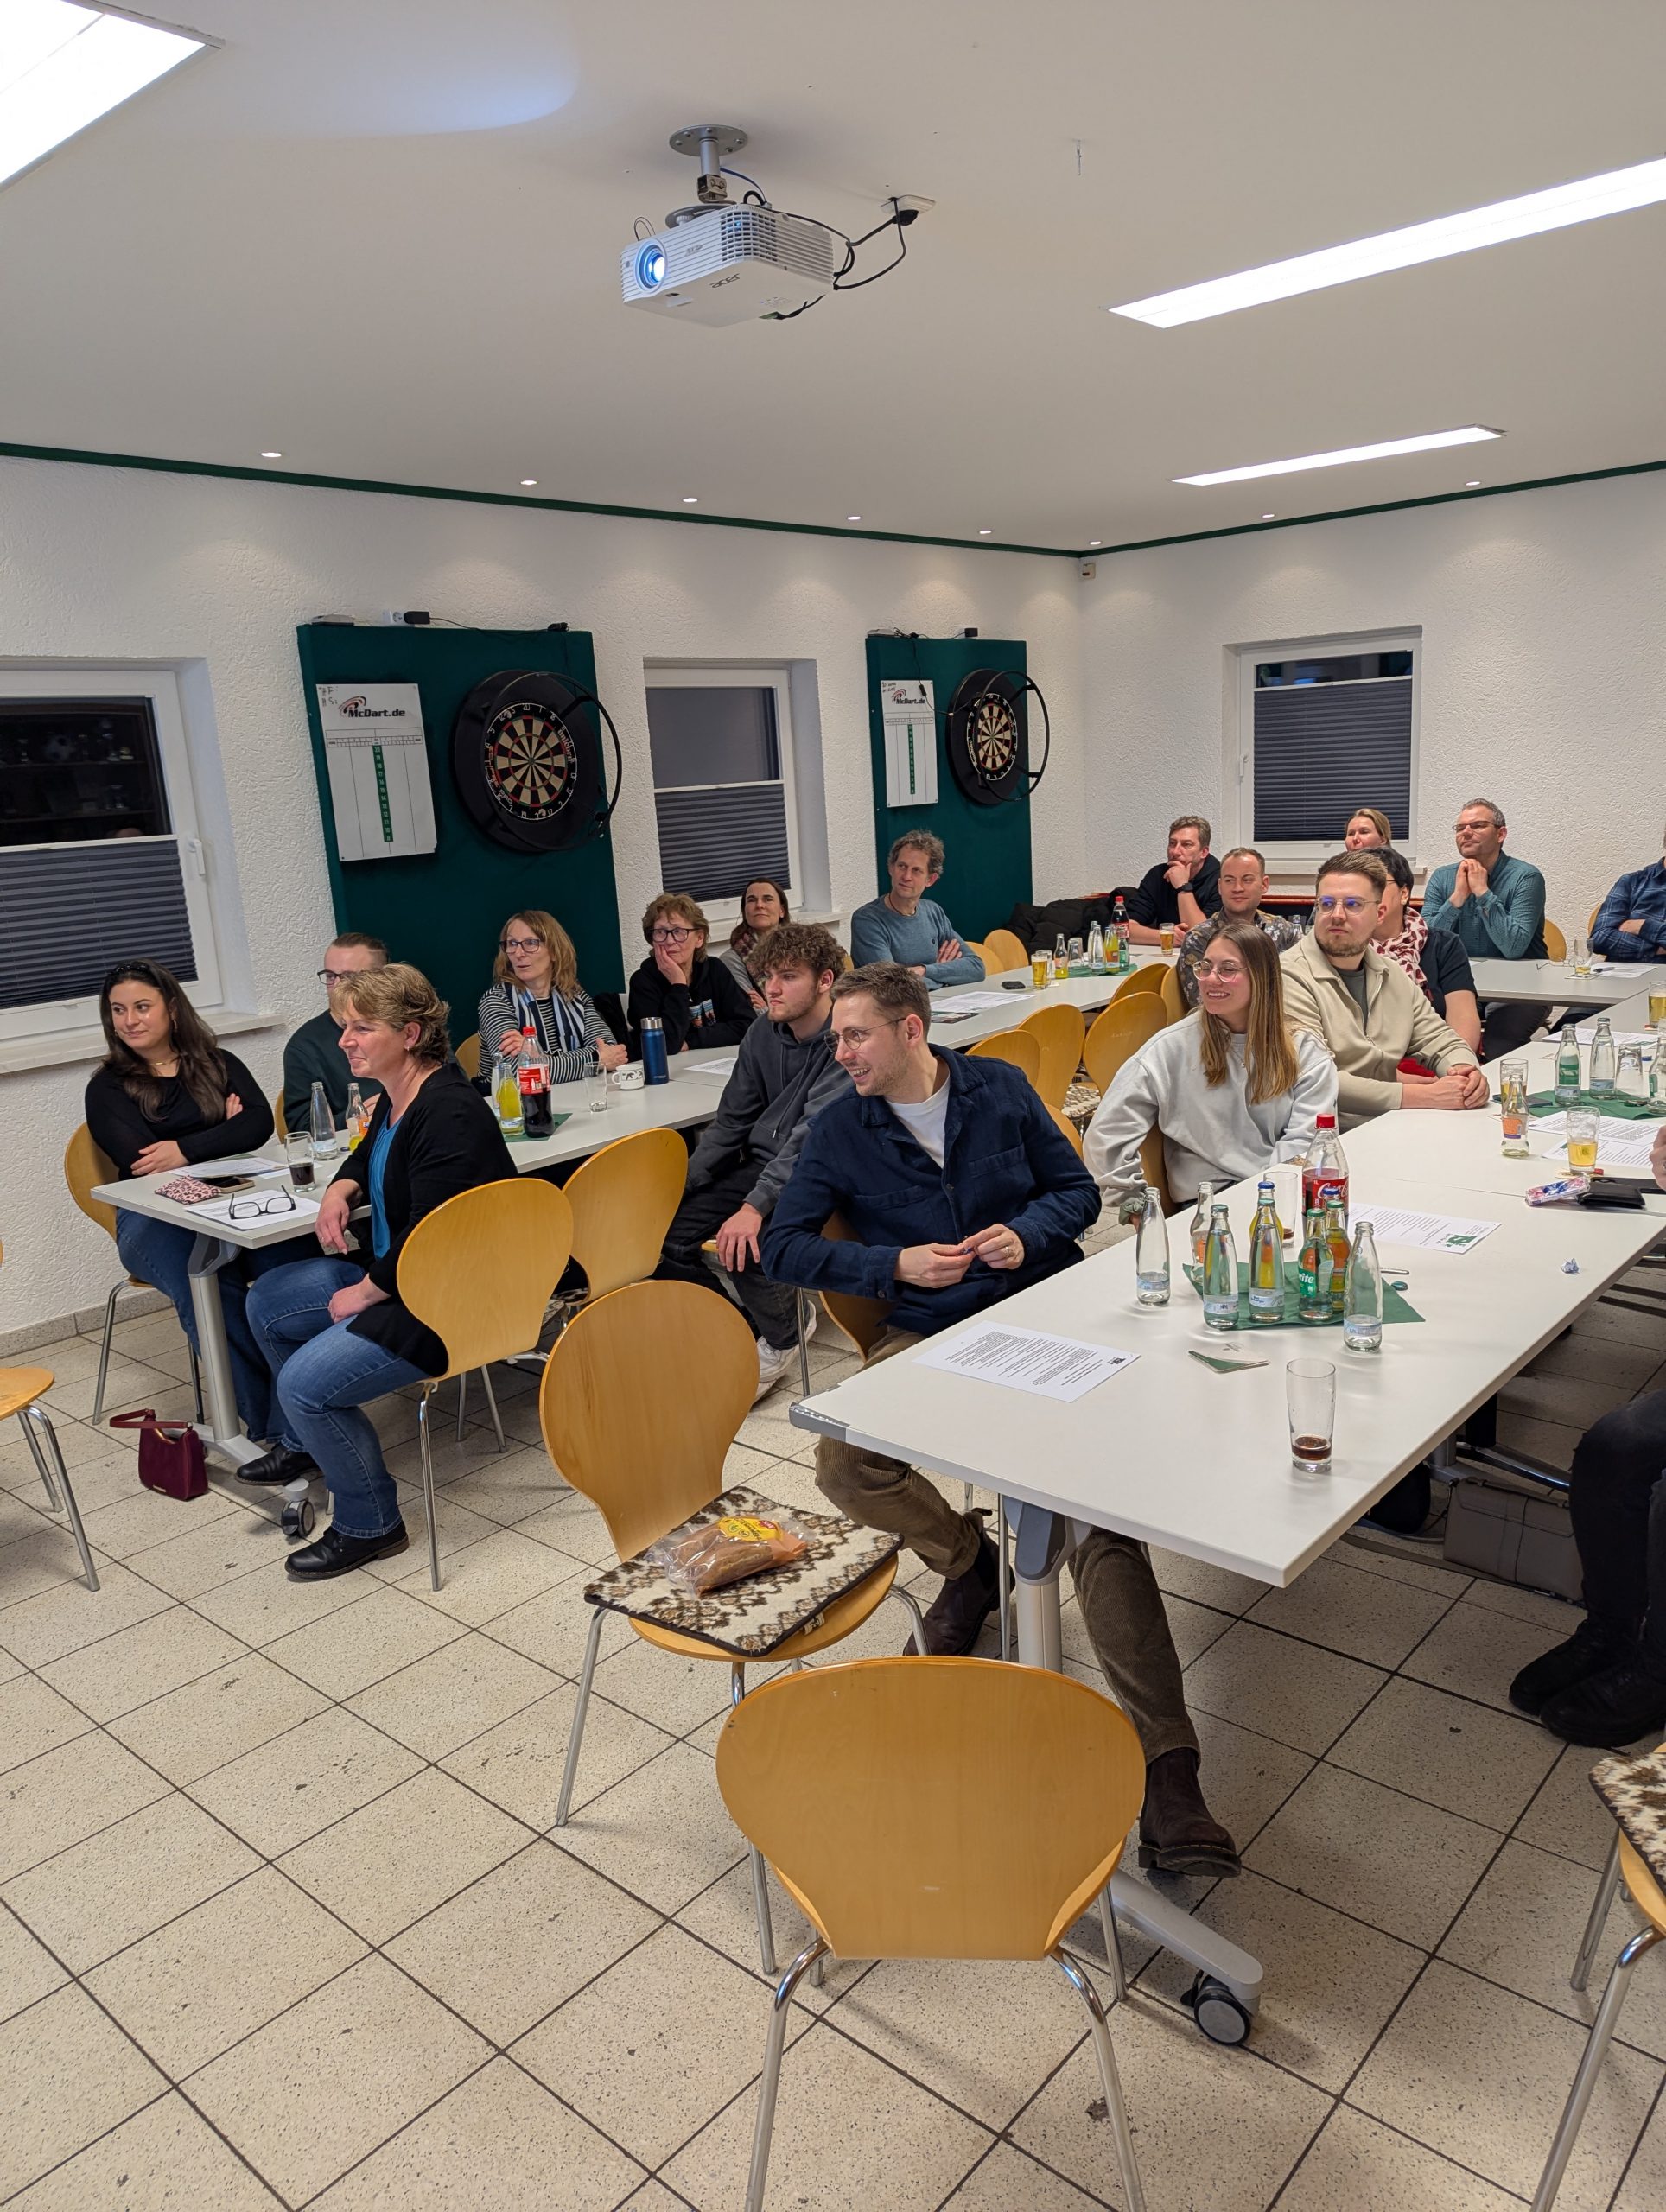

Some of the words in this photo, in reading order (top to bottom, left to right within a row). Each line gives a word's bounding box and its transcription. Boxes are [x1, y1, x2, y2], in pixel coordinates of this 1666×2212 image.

[709, 273, 741, 288] acer
[348, 709, 405, 717] McDart.de
[499, 788, 514, 805] PRO
[1299, 1272, 1314, 1284] rite
